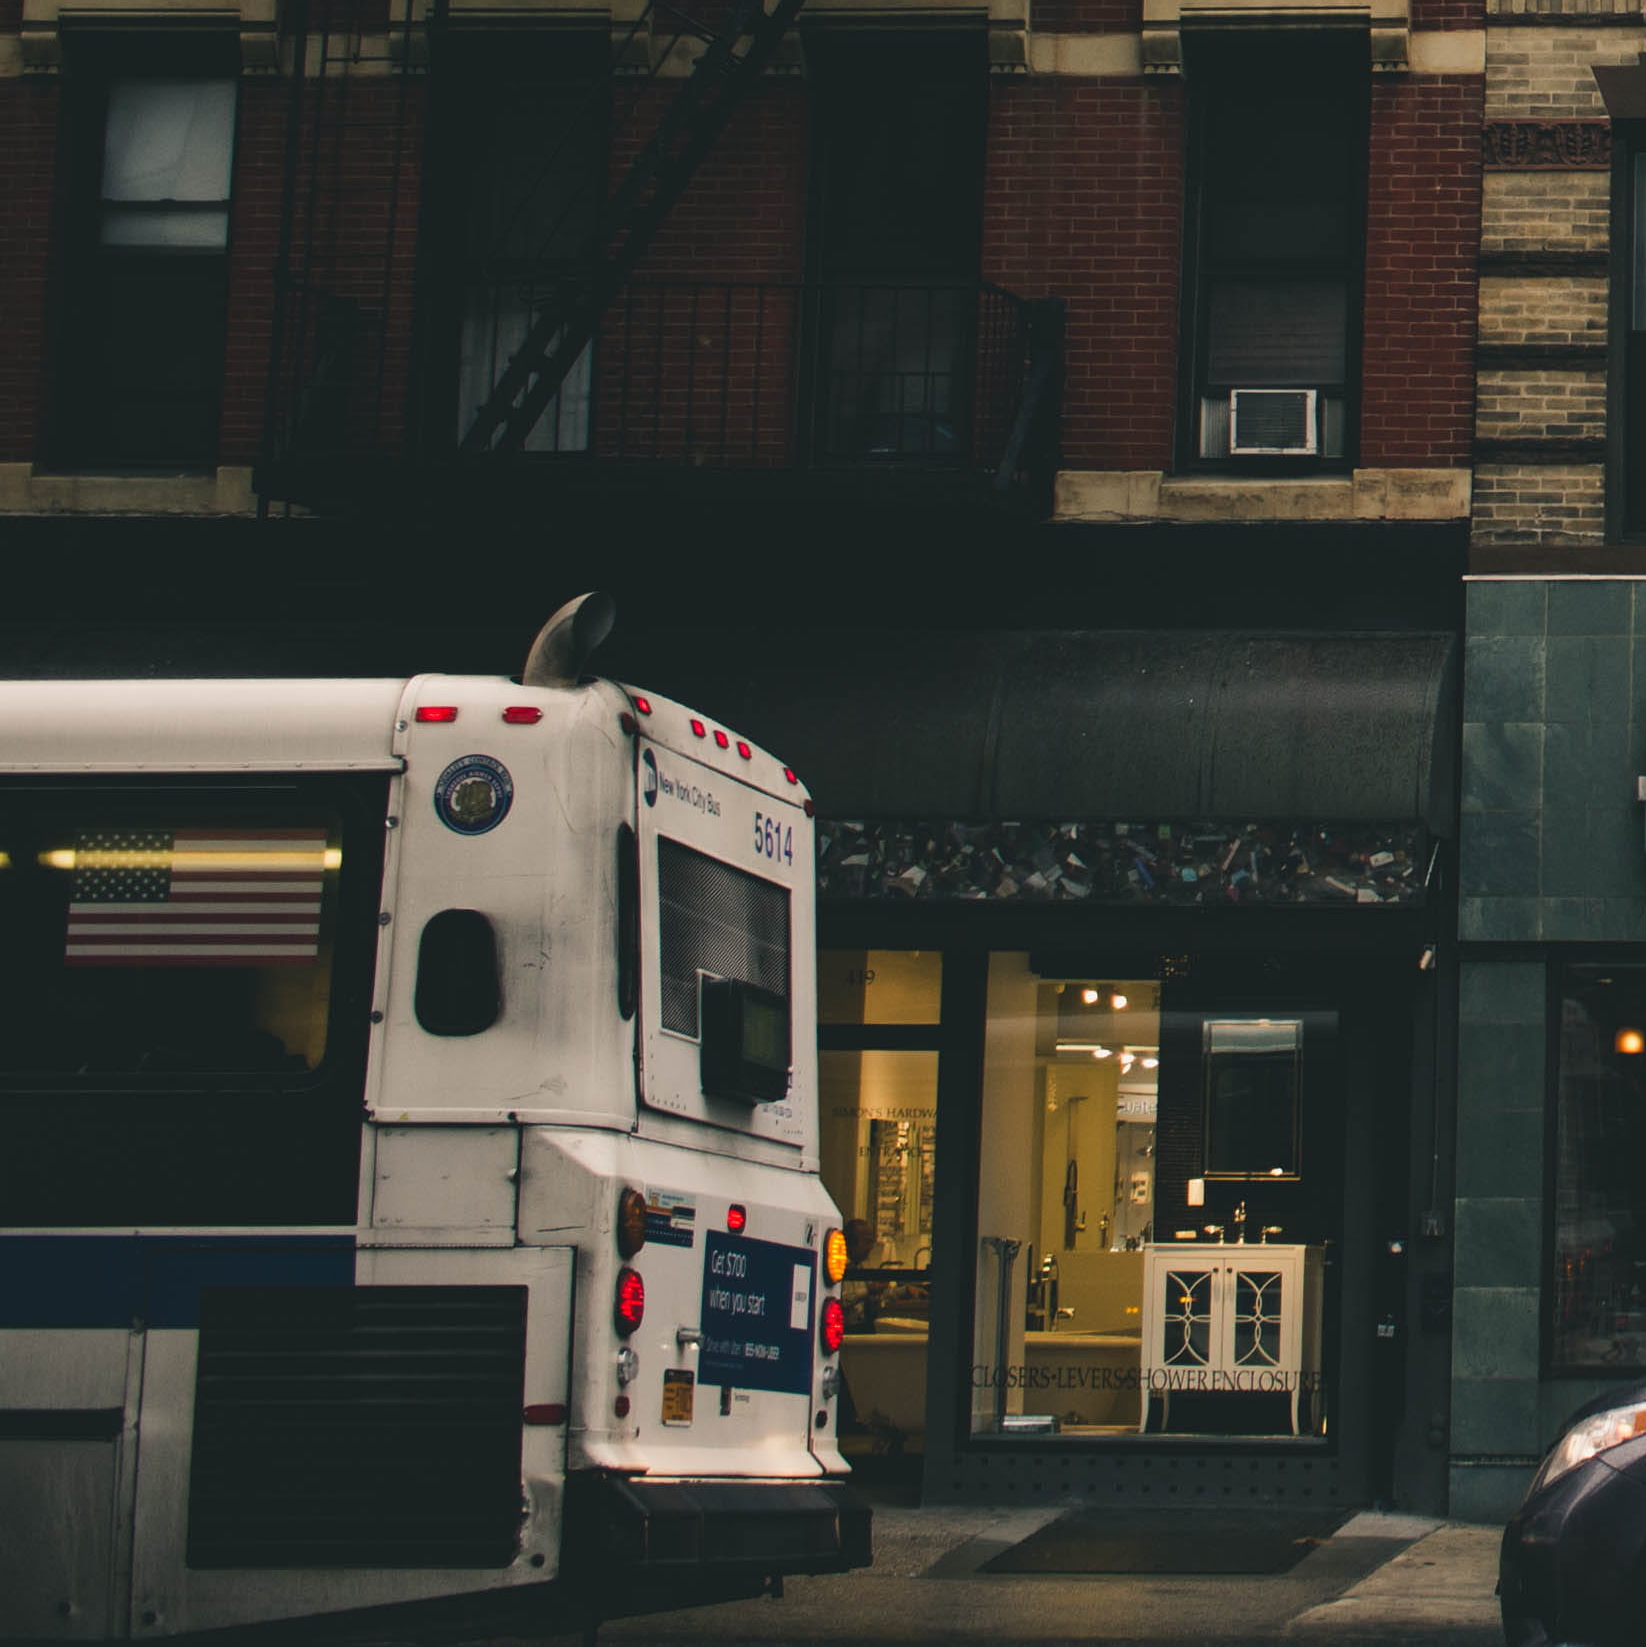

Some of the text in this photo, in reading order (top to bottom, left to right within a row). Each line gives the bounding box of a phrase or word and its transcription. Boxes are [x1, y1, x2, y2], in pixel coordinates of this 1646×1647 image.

[659, 771, 674, 795] New
[675, 777, 691, 805] York
[692, 786, 707, 814] City
[707, 792, 721, 817] Bus
[755, 811, 793, 866] 5614
[711, 1250, 725, 1274] Get
[709, 1285, 765, 1316] when you start
